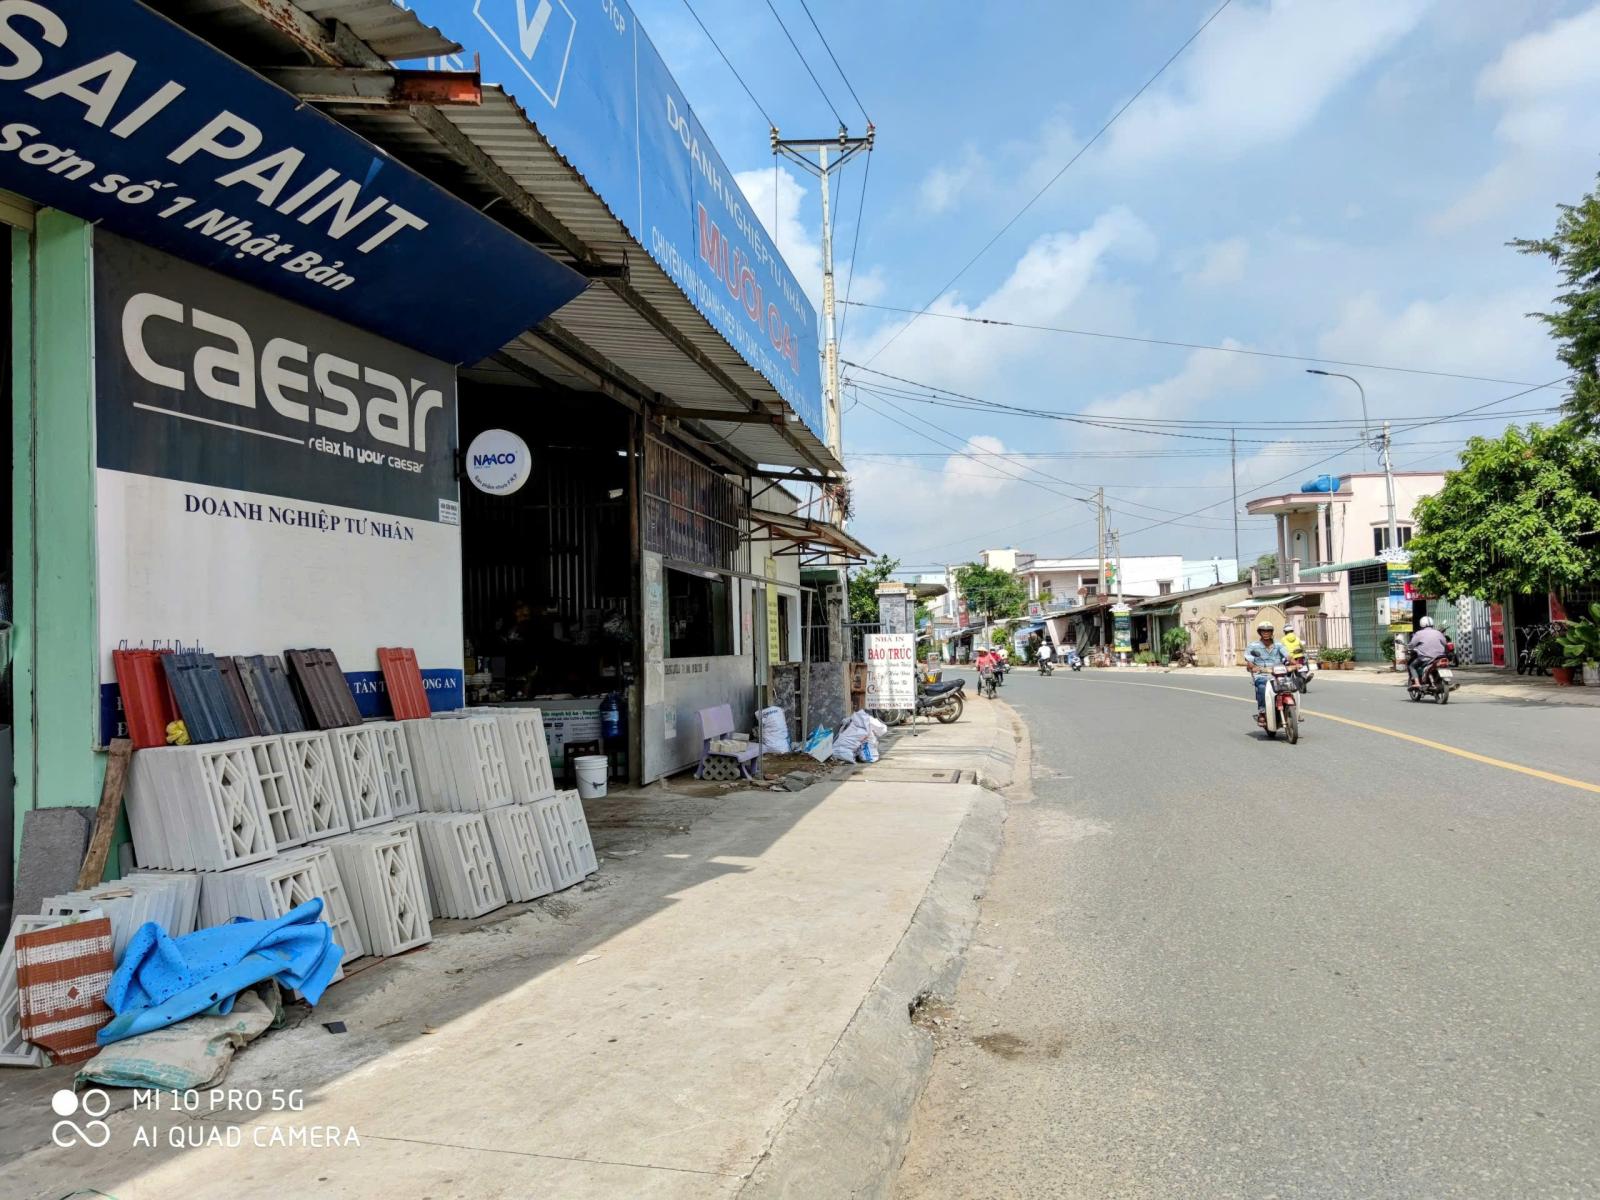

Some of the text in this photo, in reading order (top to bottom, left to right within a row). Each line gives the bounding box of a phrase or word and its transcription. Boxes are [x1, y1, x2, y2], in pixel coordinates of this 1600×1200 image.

[666, 93, 723, 201] DOANH
[166, 110, 429, 255] PAINT
[0, 122, 356, 291] Sơn số 1 Nhật Bản
[308, 436, 341, 456] relax
[356, 447, 386, 465] your
[473, 453, 516, 466] NAACO
[184, 494, 414, 541] DOANH NGHIỆP TƯ NHÂN
[887, 644, 912, 660] TRÚC
[353, 678, 377, 694] TÂN
[422, 678, 442, 690] ONG
[443, 677, 457, 689] AN
